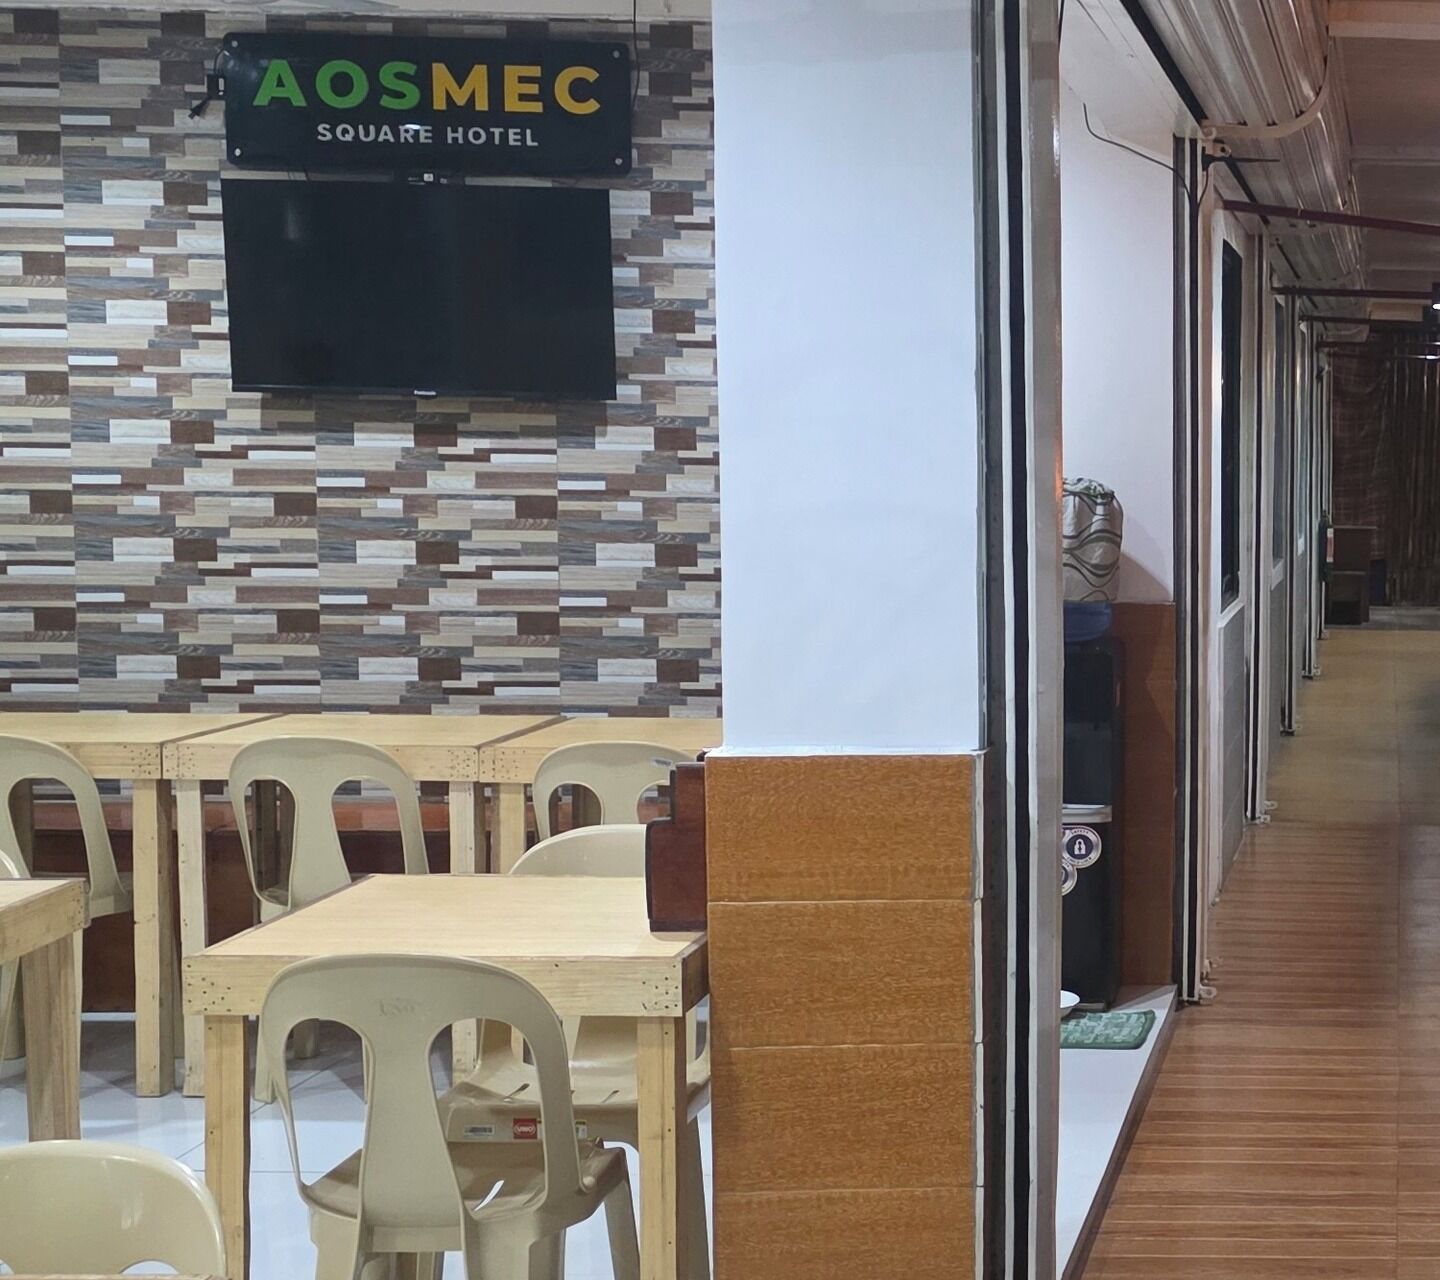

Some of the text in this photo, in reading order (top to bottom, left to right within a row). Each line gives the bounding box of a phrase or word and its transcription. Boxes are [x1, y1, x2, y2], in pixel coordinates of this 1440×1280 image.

[253, 59, 601, 115] AOSMEC
[317, 124, 538, 147] SQUARE HOTEL
